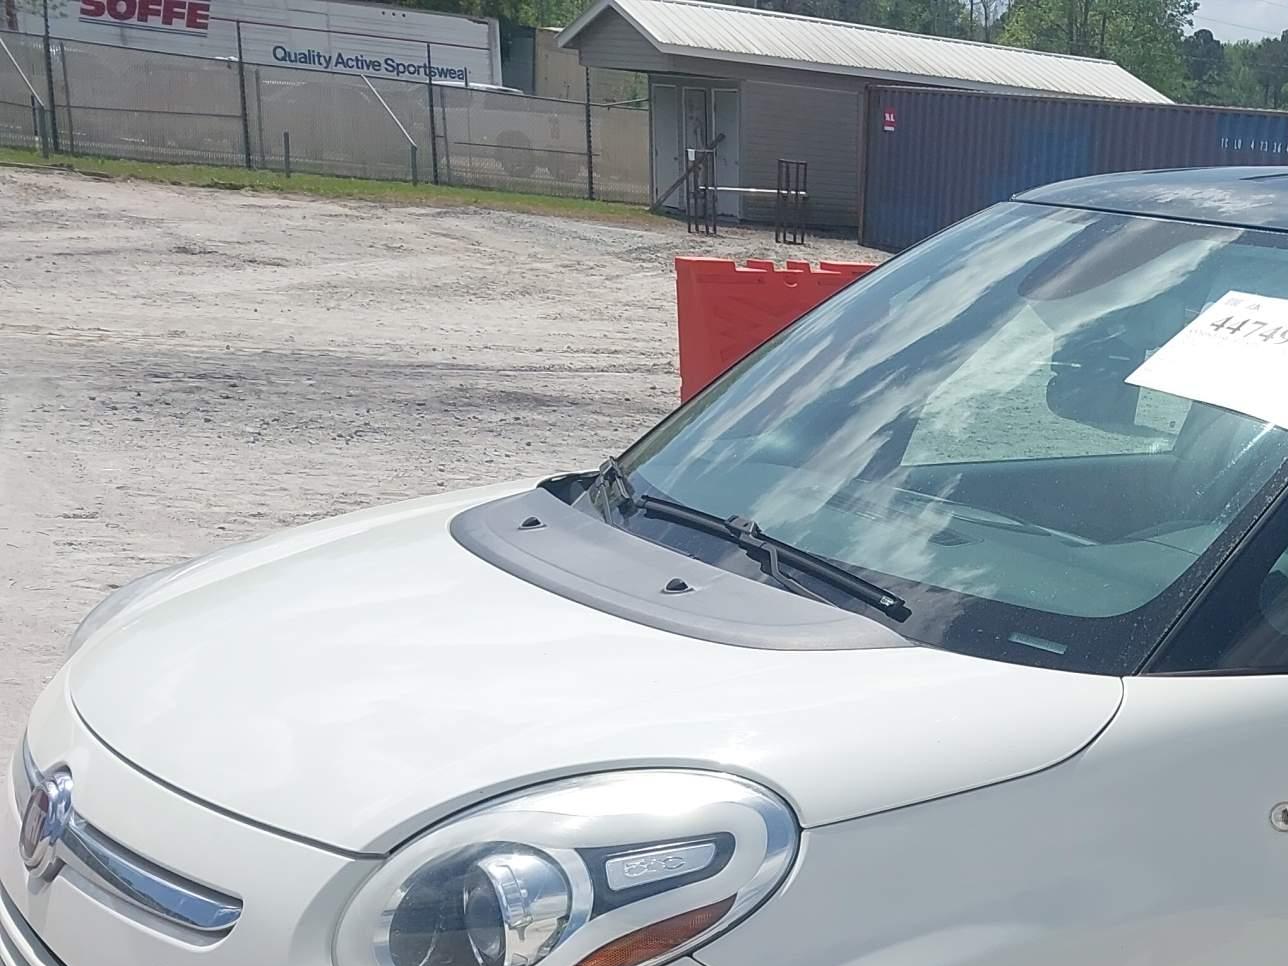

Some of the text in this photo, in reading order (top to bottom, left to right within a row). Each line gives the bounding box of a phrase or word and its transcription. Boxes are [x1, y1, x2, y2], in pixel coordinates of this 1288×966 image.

[80, 0, 210, 30] SOFFE
[272, 45, 332, 69] Quality
[334, 52, 381, 72] Active
